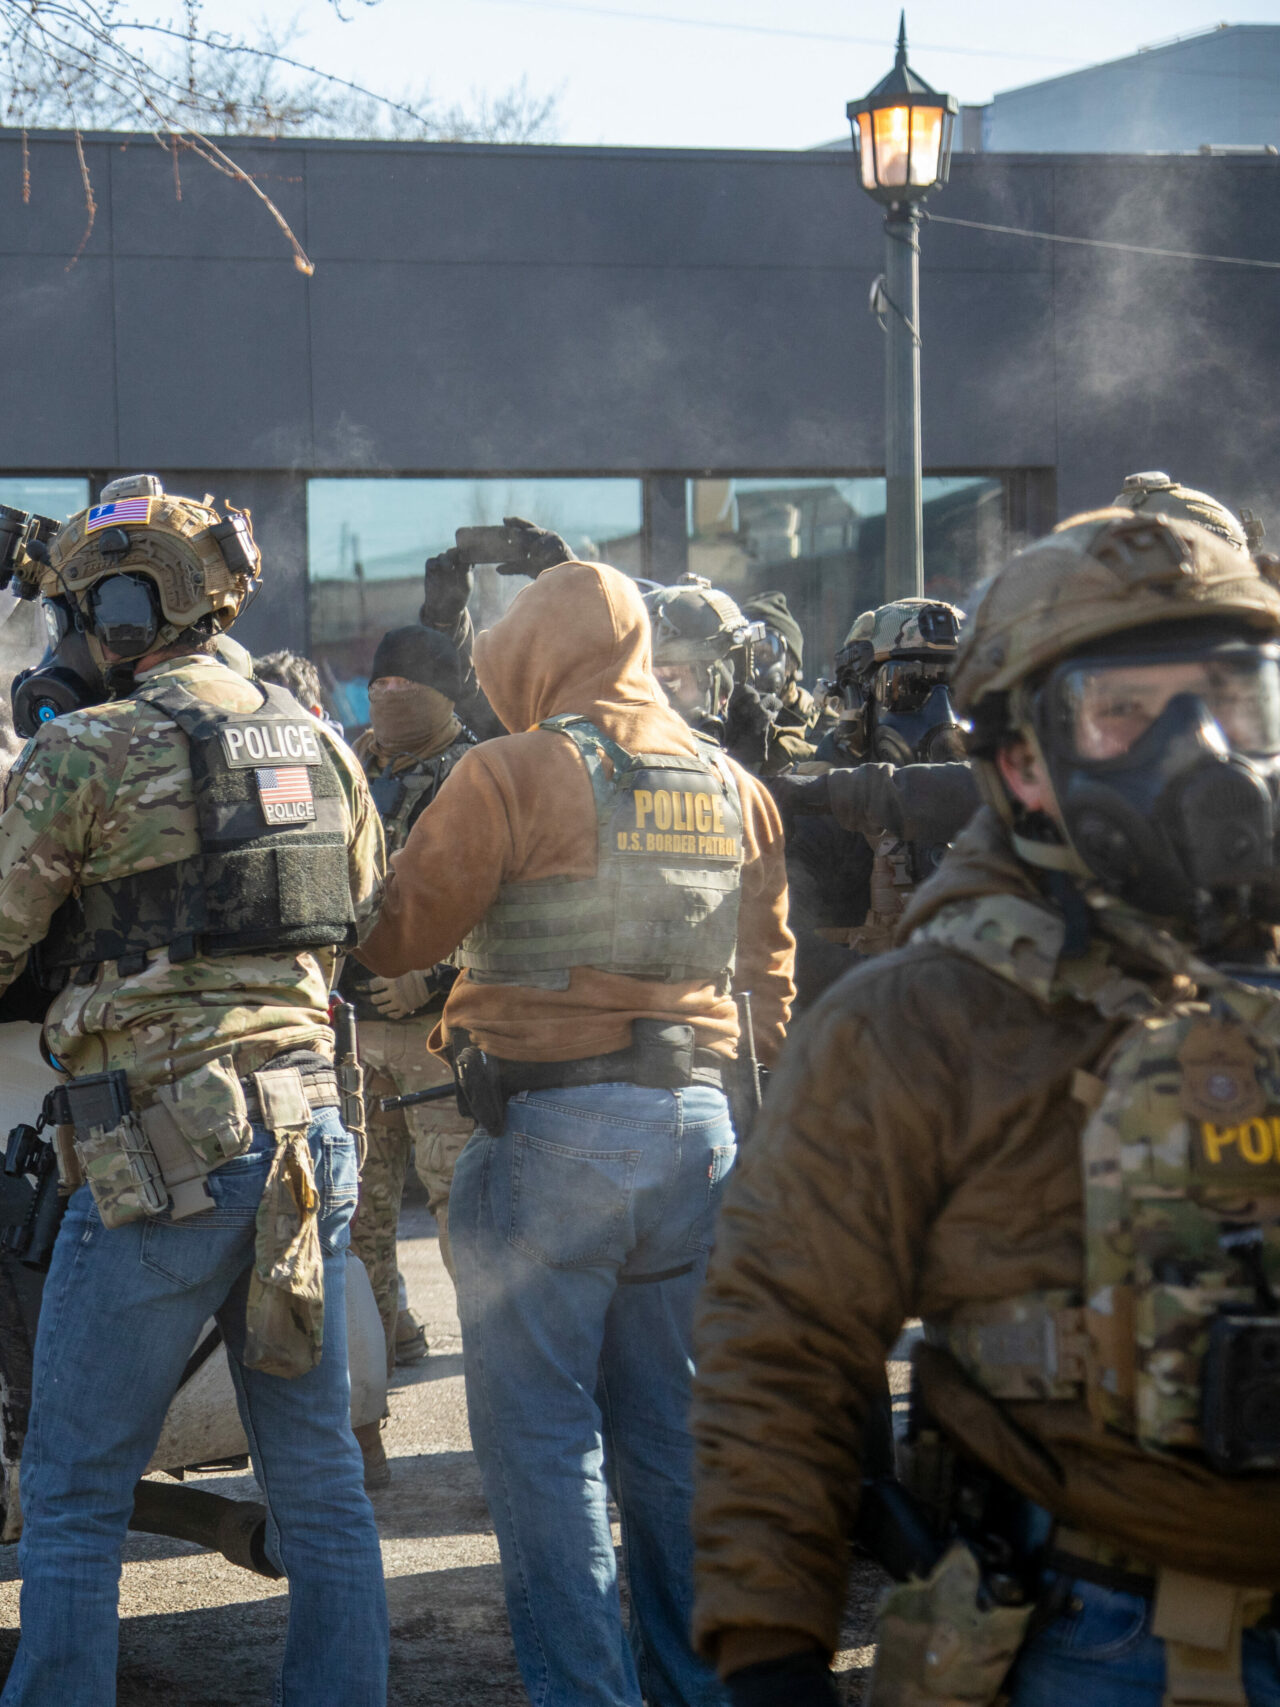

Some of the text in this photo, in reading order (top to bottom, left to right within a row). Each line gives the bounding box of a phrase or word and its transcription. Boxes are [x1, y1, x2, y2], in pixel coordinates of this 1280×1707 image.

[224, 725, 317, 761] POLICE
[264, 801, 315, 819] POLICE
[633, 789, 725, 834] POLICE
[617, 832, 737, 856] U.S. BORDER PATROL
